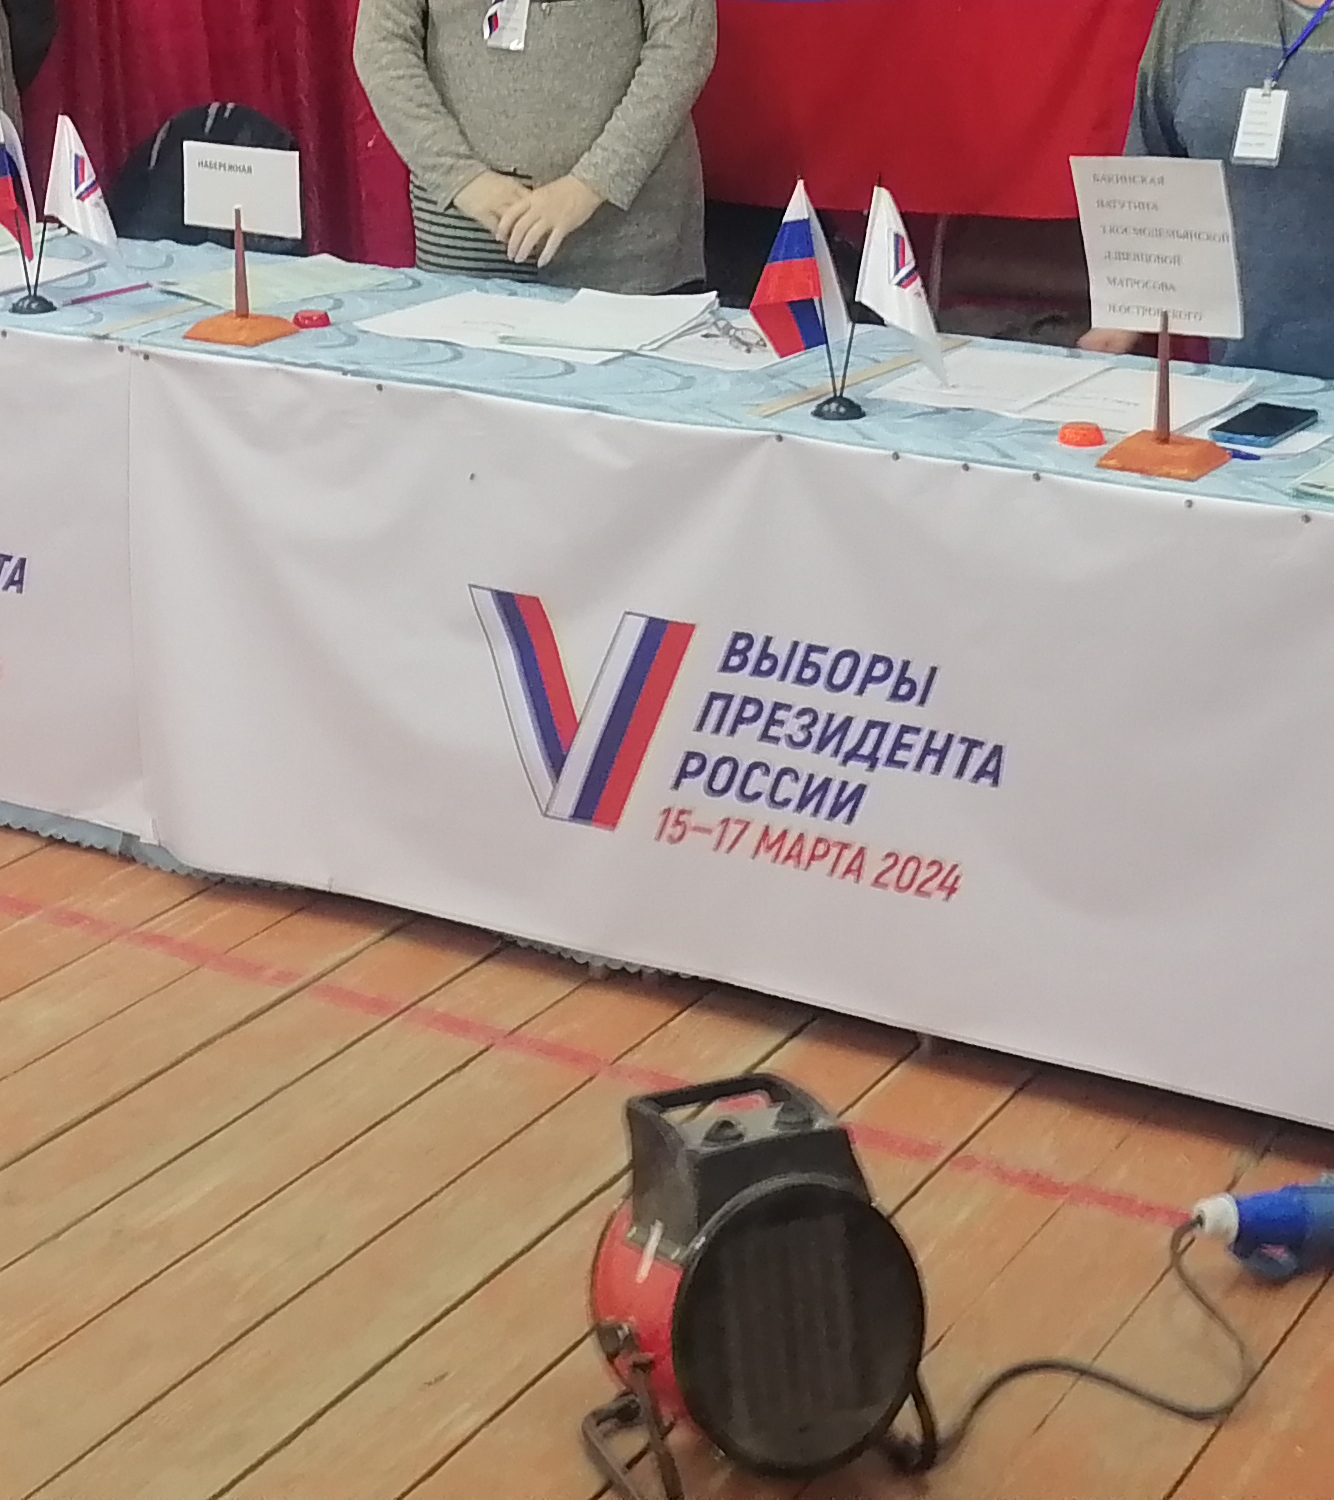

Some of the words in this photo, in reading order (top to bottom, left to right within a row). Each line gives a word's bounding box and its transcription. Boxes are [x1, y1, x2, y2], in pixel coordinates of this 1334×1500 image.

[197, 160, 253, 174] НАБЕРЕЖНАЯ
[1092, 172, 1165, 187] БАКИНСКАЯ
[1096, 199, 1159, 212] ВАТУТИНА
[1106, 276, 1177, 293] МАТРОСОВА
[717, 630, 939, 708] ВЫБОРЫ
[693, 691, 1006, 788] ПРЕЗИДЕНТА
[670, 750, 867, 826] РОССИИ
[751, 824, 869, 885] МАРТА
[870, 851, 964, 902] 2024
